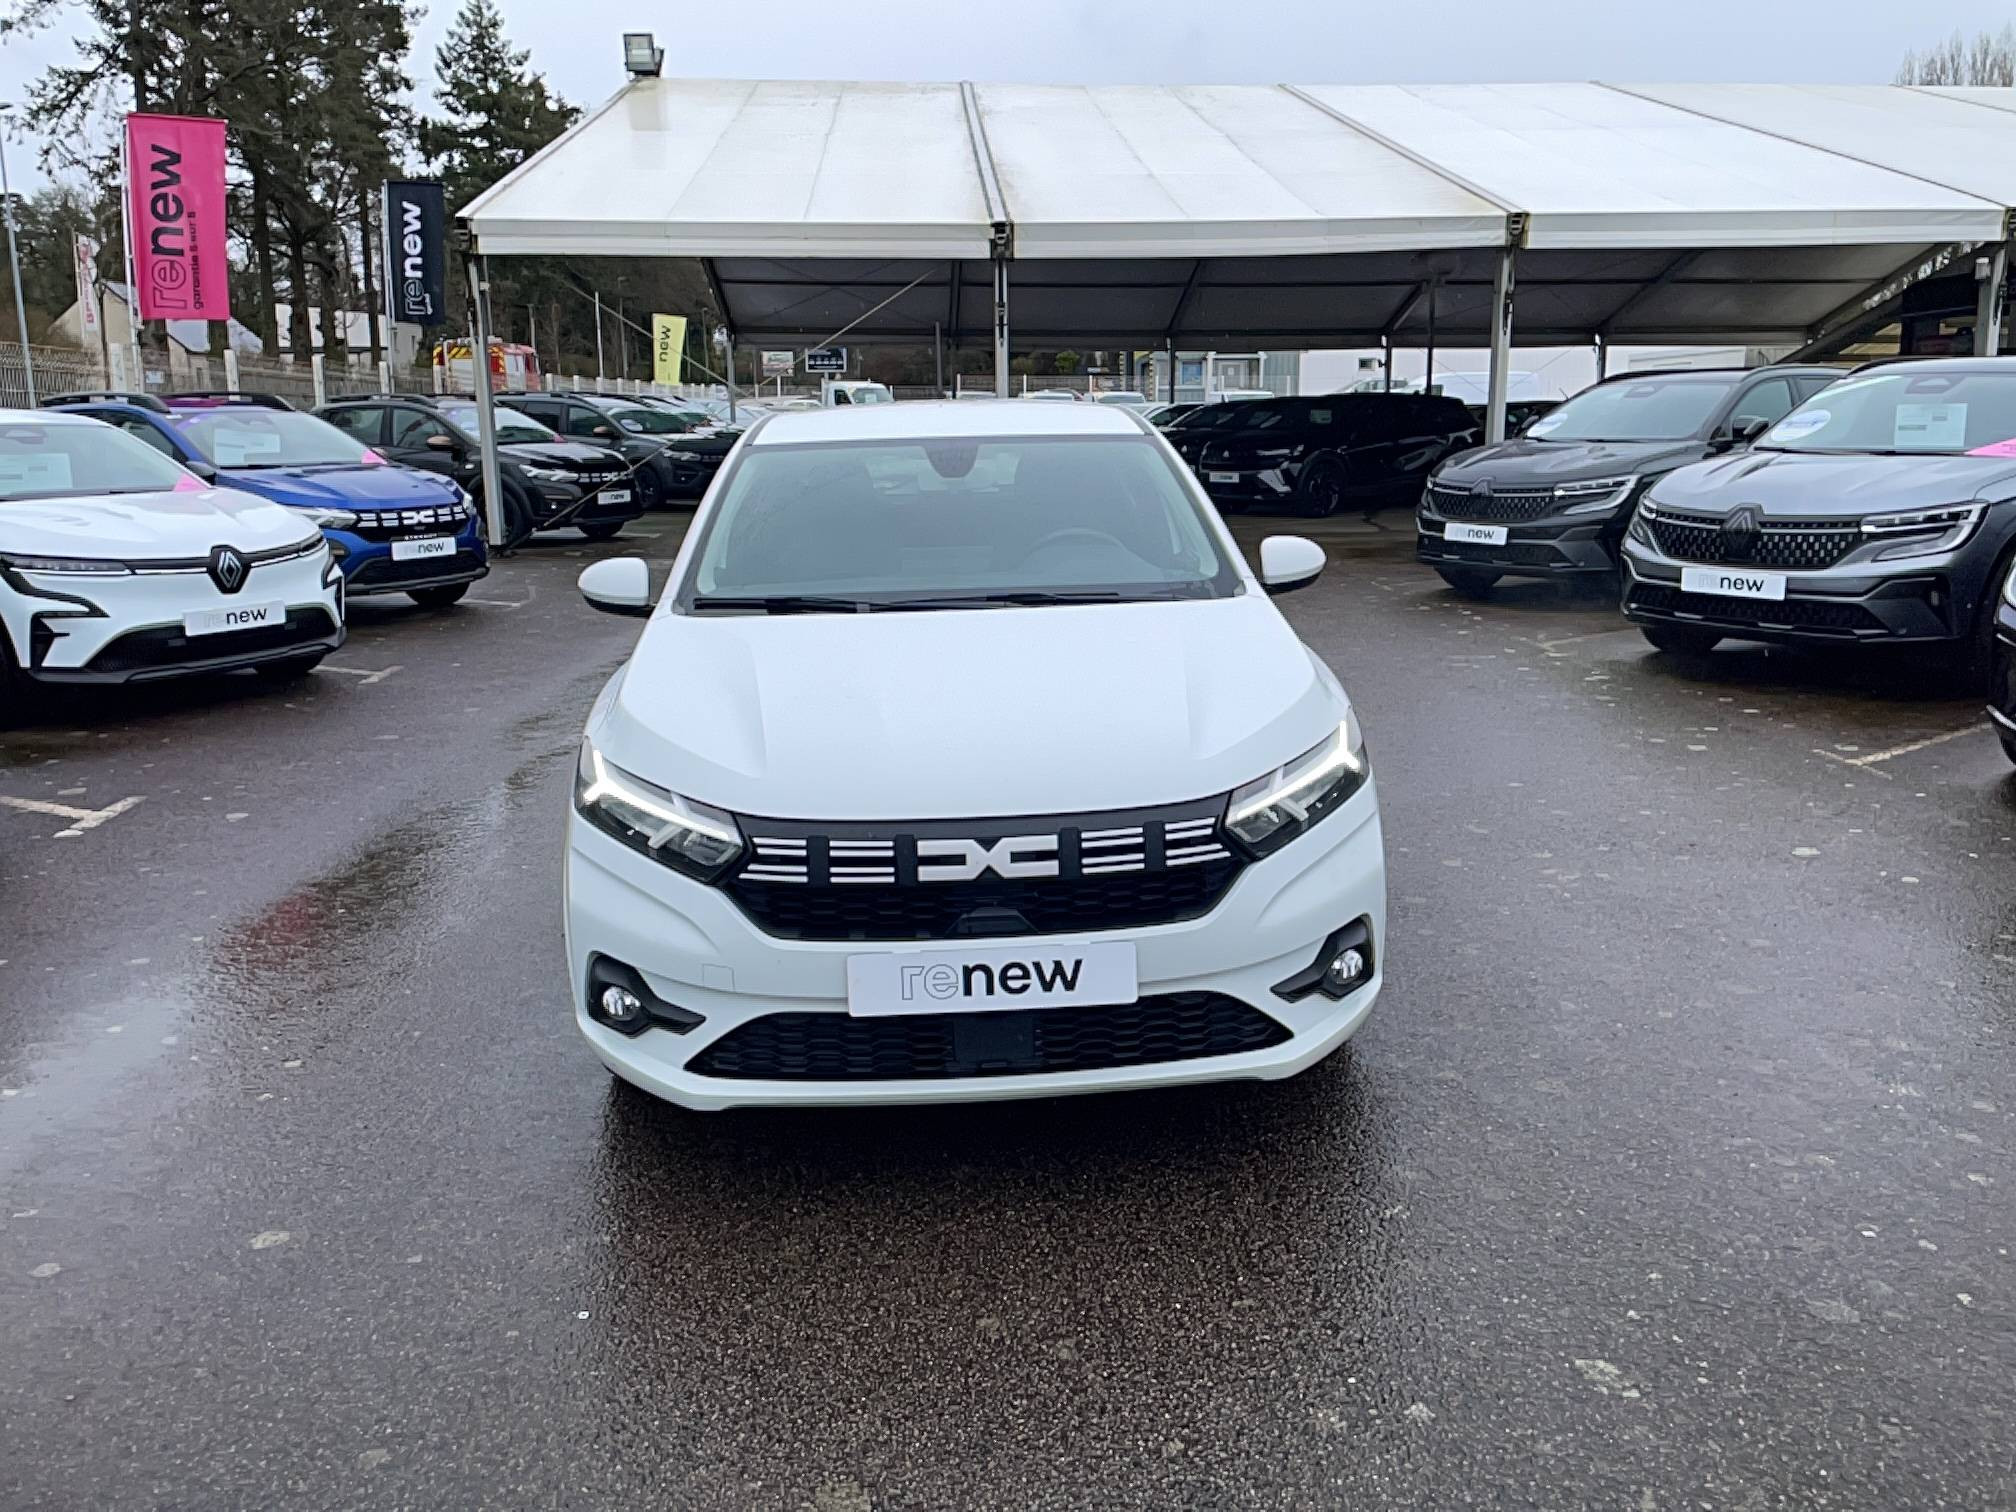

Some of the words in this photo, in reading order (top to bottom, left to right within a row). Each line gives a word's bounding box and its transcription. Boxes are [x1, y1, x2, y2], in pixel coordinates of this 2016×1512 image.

[150, 143, 187, 310] renew
[402, 200, 426, 315] renew
[191, 255, 204, 310] garantie
[900, 958, 1084, 1001] renew
